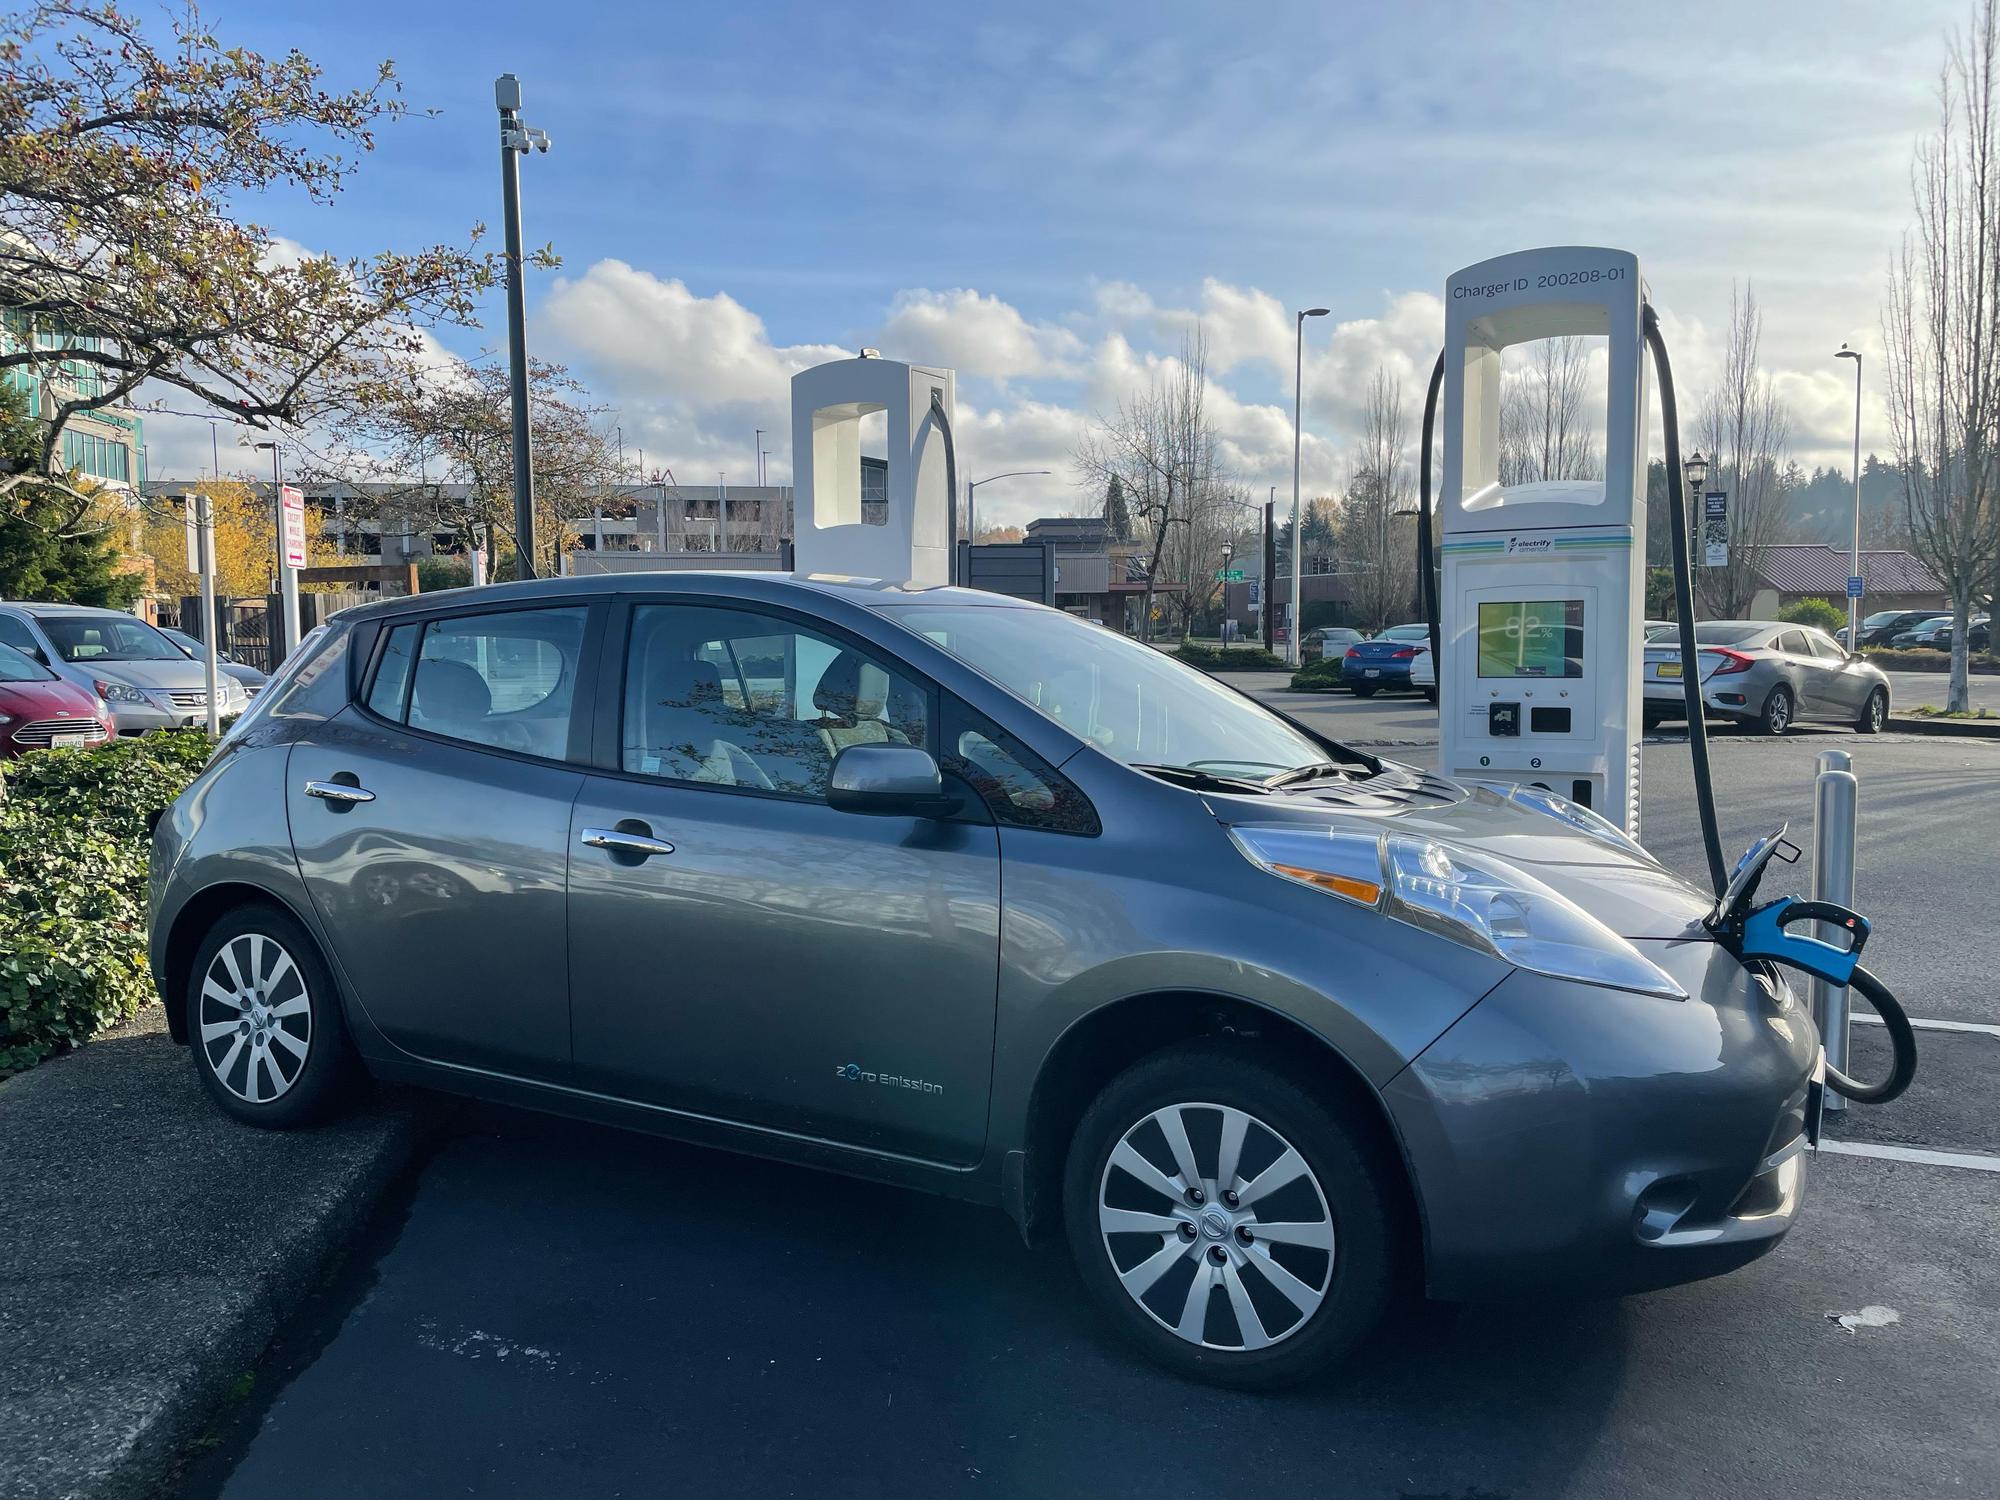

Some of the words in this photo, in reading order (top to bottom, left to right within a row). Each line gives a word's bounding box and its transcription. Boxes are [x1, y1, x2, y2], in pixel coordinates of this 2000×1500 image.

[1453, 282, 1510, 299] Charger
[1513, 278, 1529, 291] ID
[1537, 267, 1625, 289] 200208-01
[1518, 539, 1551, 548] electrify
[879, 1073, 943, 1095] Emission
